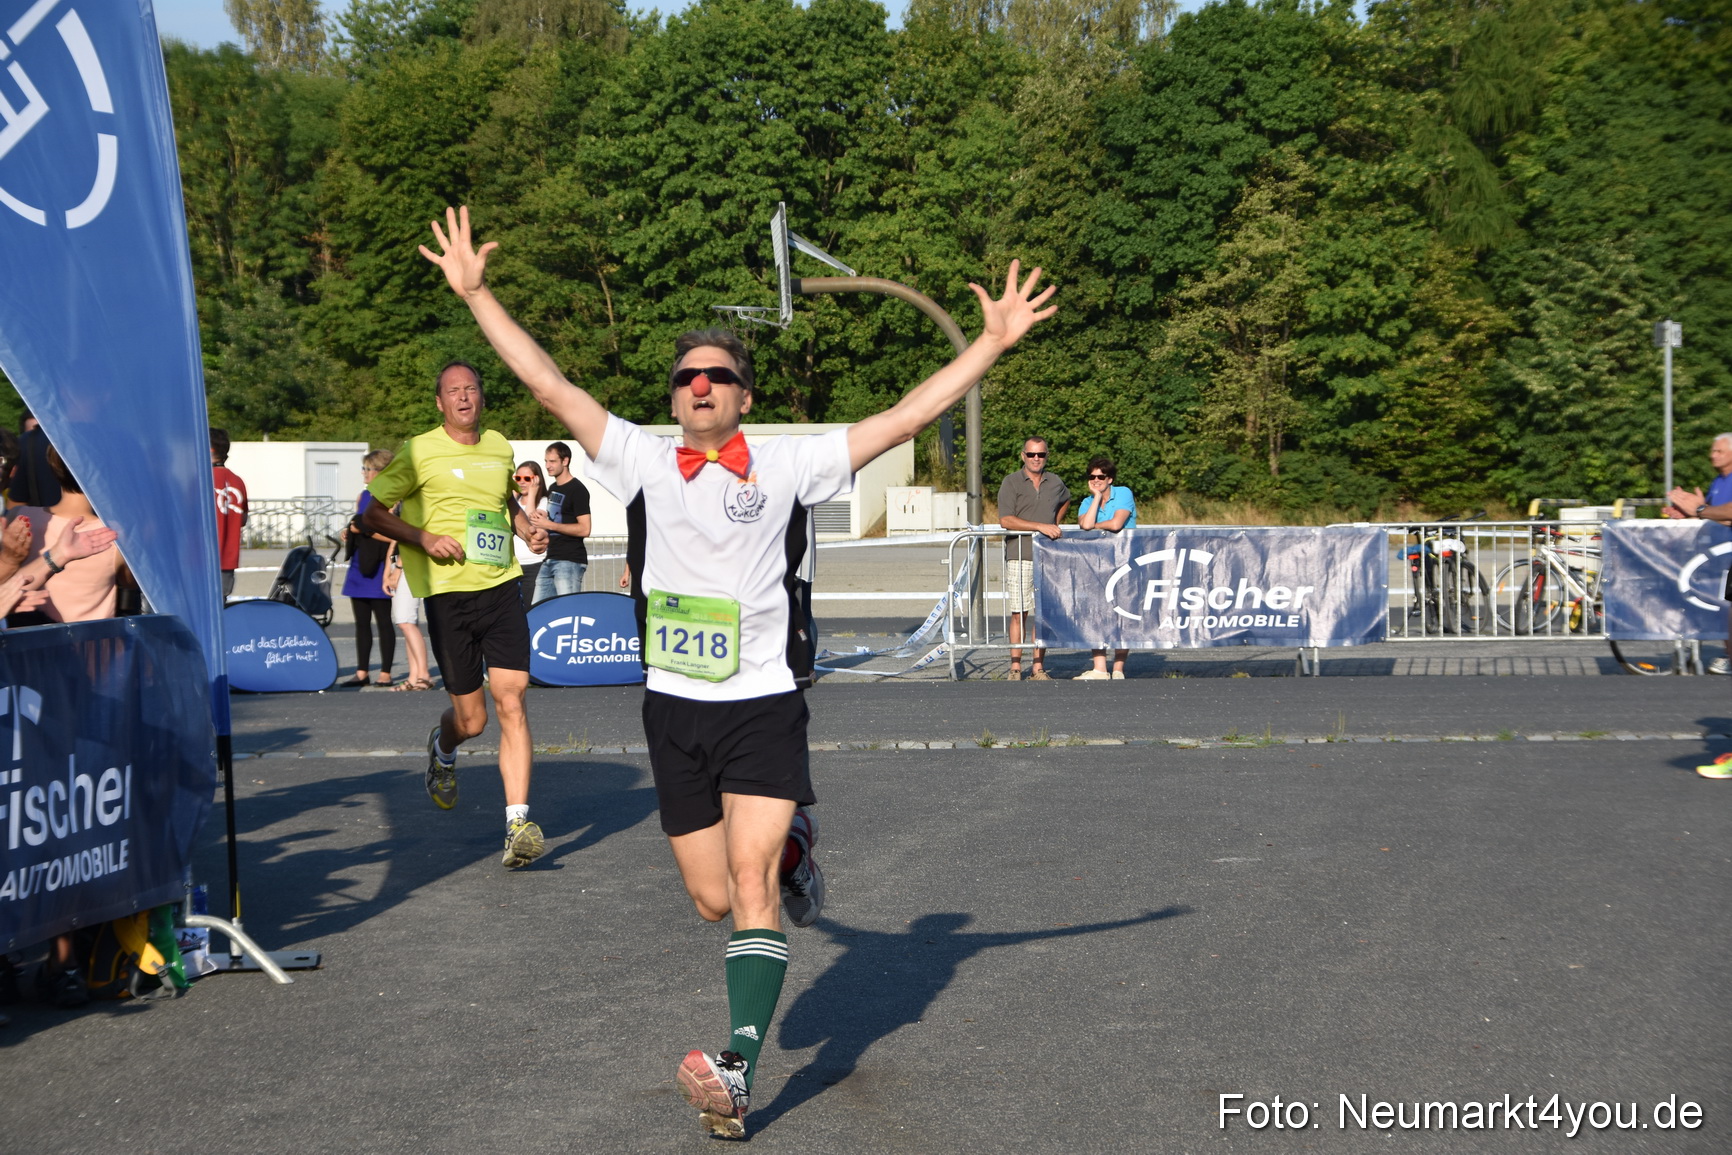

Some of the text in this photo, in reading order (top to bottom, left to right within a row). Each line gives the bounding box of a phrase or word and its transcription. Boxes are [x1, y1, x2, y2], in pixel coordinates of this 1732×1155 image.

[477, 532, 505, 551] 637
[1143, 578, 1314, 611] Fischer
[1158, 614, 1301, 630] AUTOMOBILE
[257, 636, 277, 648] das
[556, 632, 640, 654] Fische
[656, 625, 728, 659] 1218
[264, 650, 319, 669] fährt mit!
[566, 654, 641, 665] AUTOMOBIL
[0, 838, 130, 901] AUTOMOBILE
